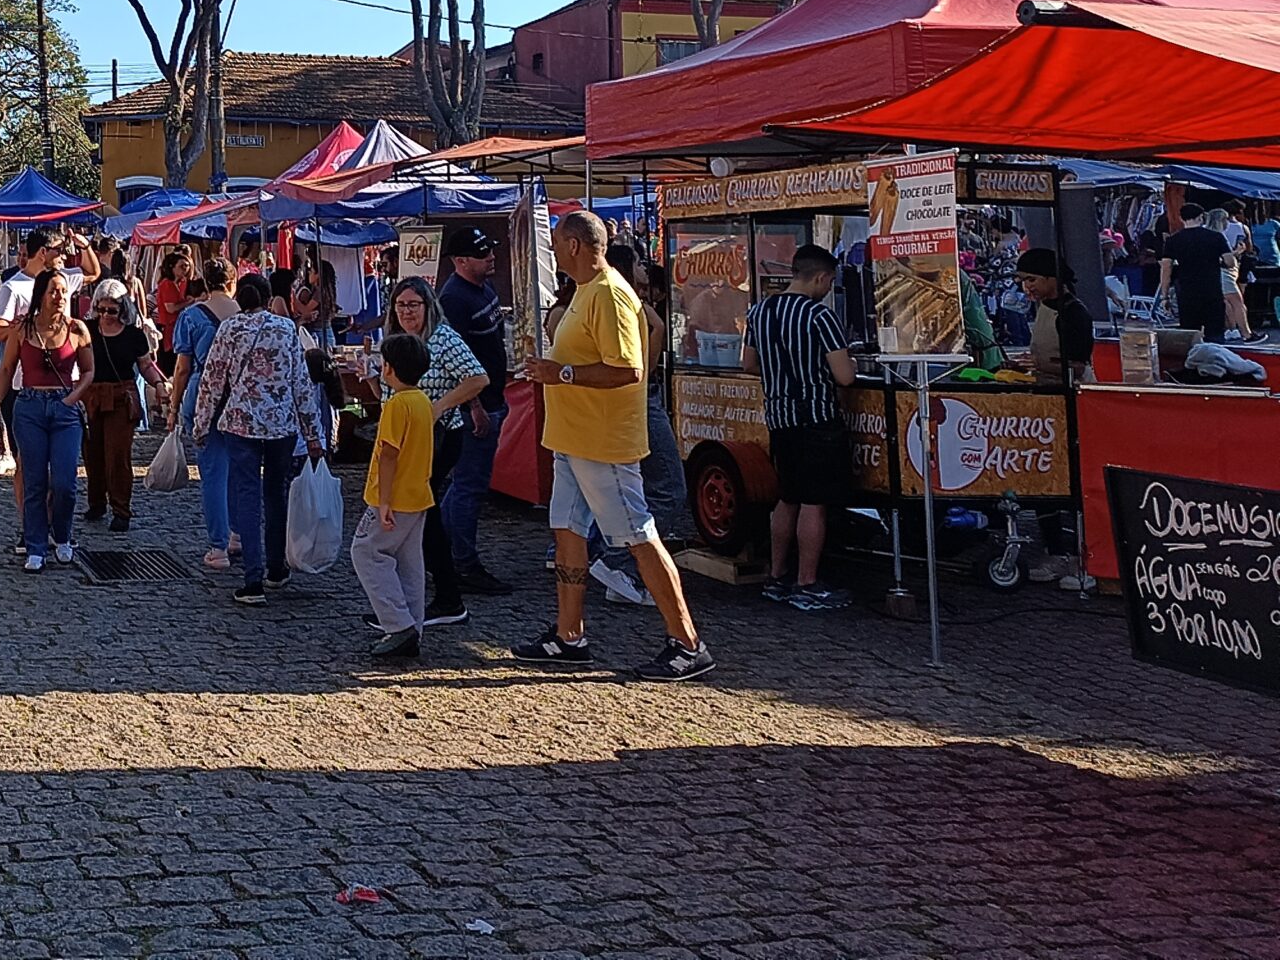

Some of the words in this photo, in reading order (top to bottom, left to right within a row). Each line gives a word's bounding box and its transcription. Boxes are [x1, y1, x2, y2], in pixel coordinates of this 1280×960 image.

[894, 155, 954, 177] TRADICIONAL
[665, 183, 720, 209] DELICIOSOS
[726, 175, 780, 208] CHURROS
[785, 166, 865, 198] RECHEADOS
[900, 187, 920, 199] DOCE
[922, 185, 932, 197] DE
[975, 171, 1050, 193] CHURROS
[906, 206, 951, 222] CHOCOLATE
[891, 241, 939, 256] GOURMET
[958, 413, 1055, 444] CHURROS
[850, 443, 881, 467] RTE
[960, 452, 982, 464] COM
[984, 446, 1053, 479] ARTE
[1134, 544, 1202, 601] ÁGUA
[1147, 602, 1166, 633] 3
